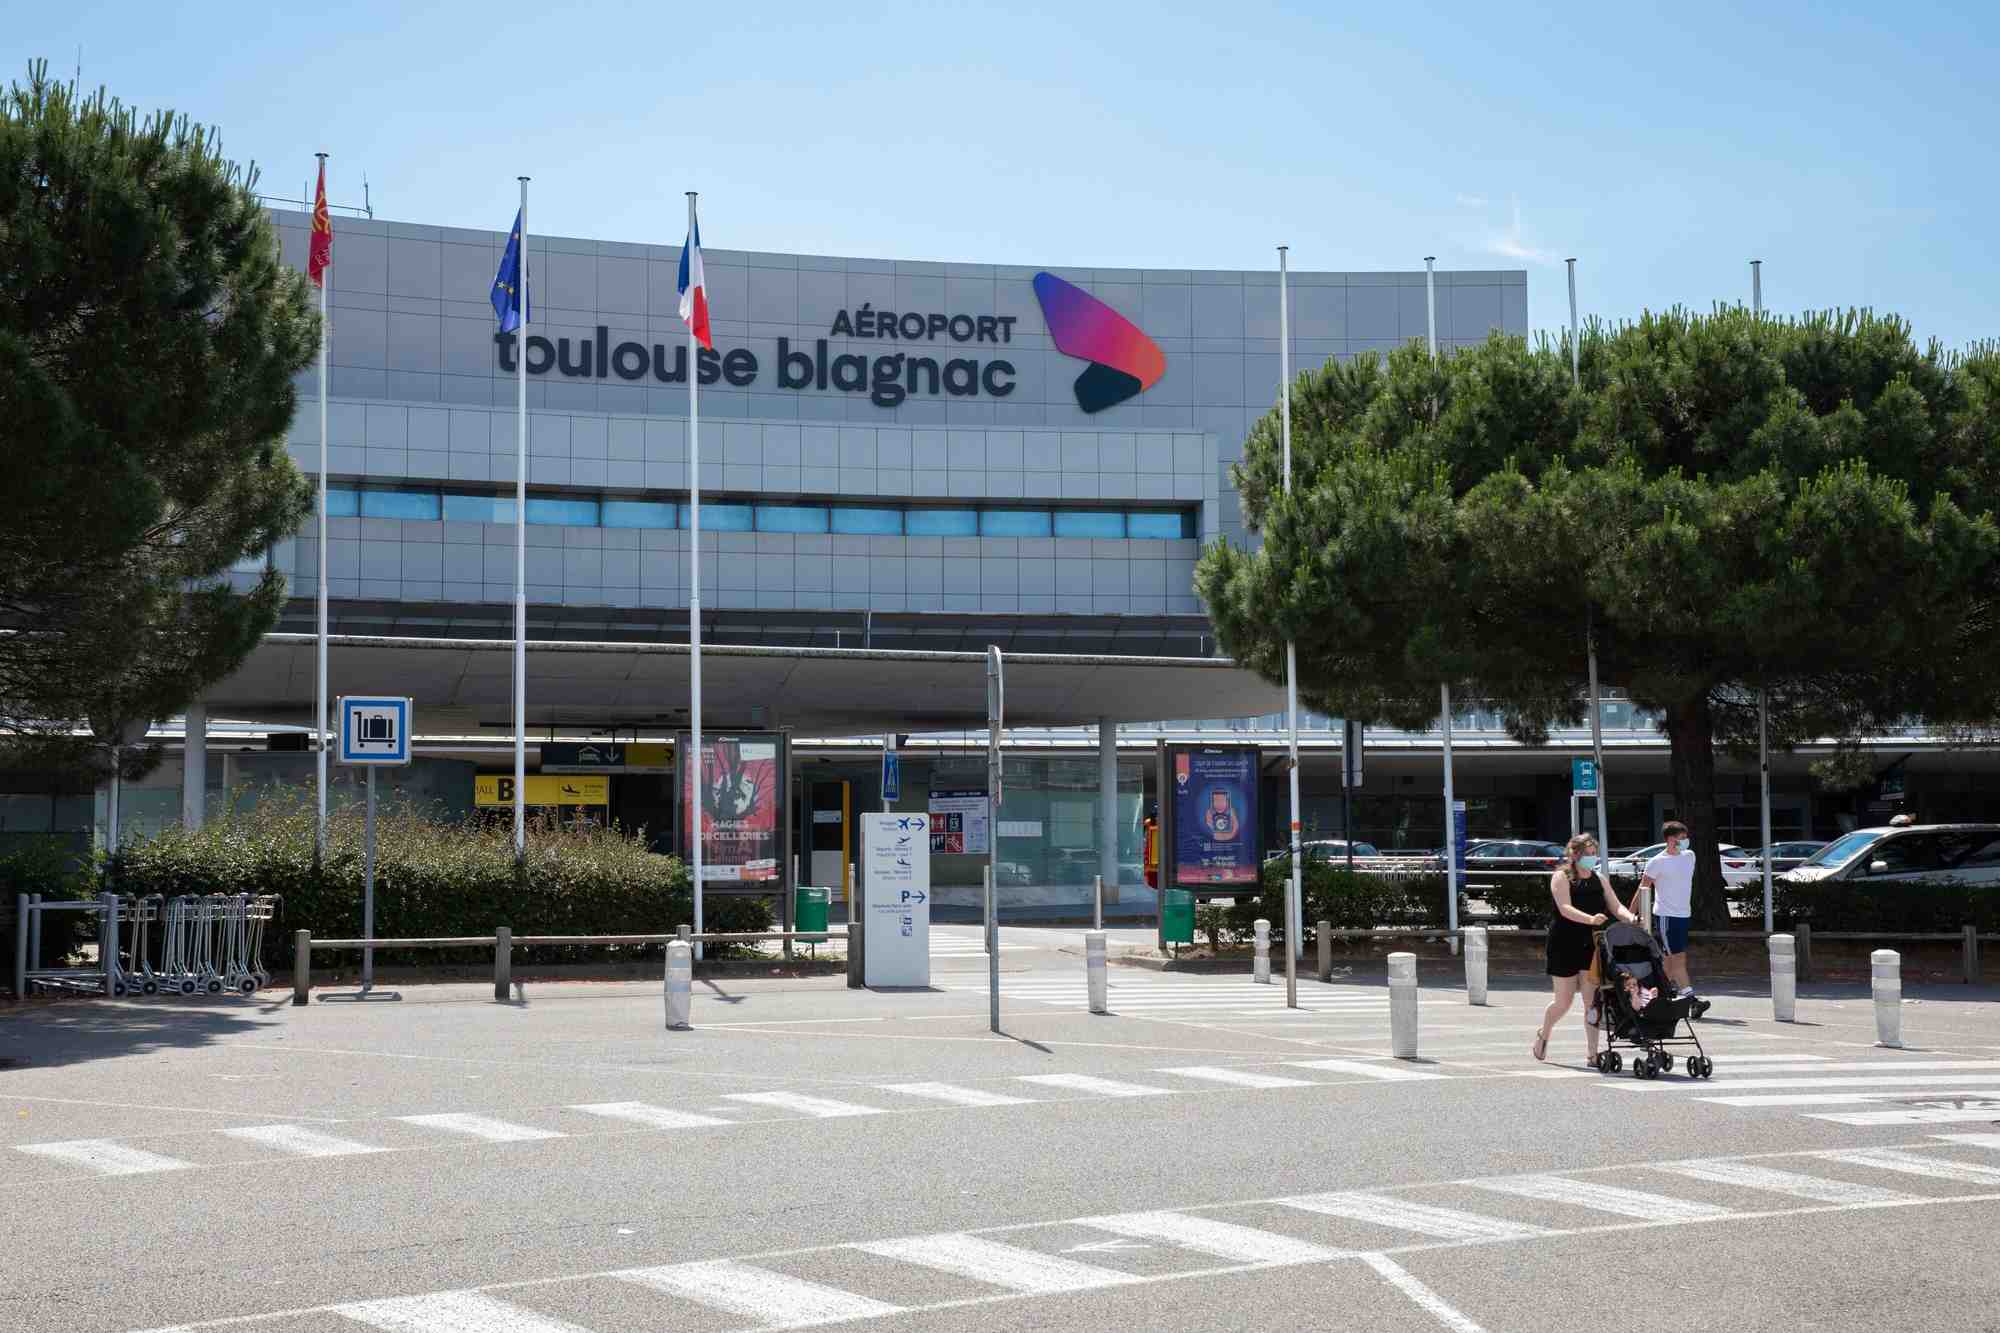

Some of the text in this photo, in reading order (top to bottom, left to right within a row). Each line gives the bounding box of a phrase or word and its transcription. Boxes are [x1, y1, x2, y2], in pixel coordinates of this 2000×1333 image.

[831, 302, 1017, 343] AÉROPORT
[494, 326, 1017, 407] toulouse blagnac
[497, 778, 515, 801] B
[700, 831, 769, 841] ORCELLERIES
[901, 890, 911, 903] P
